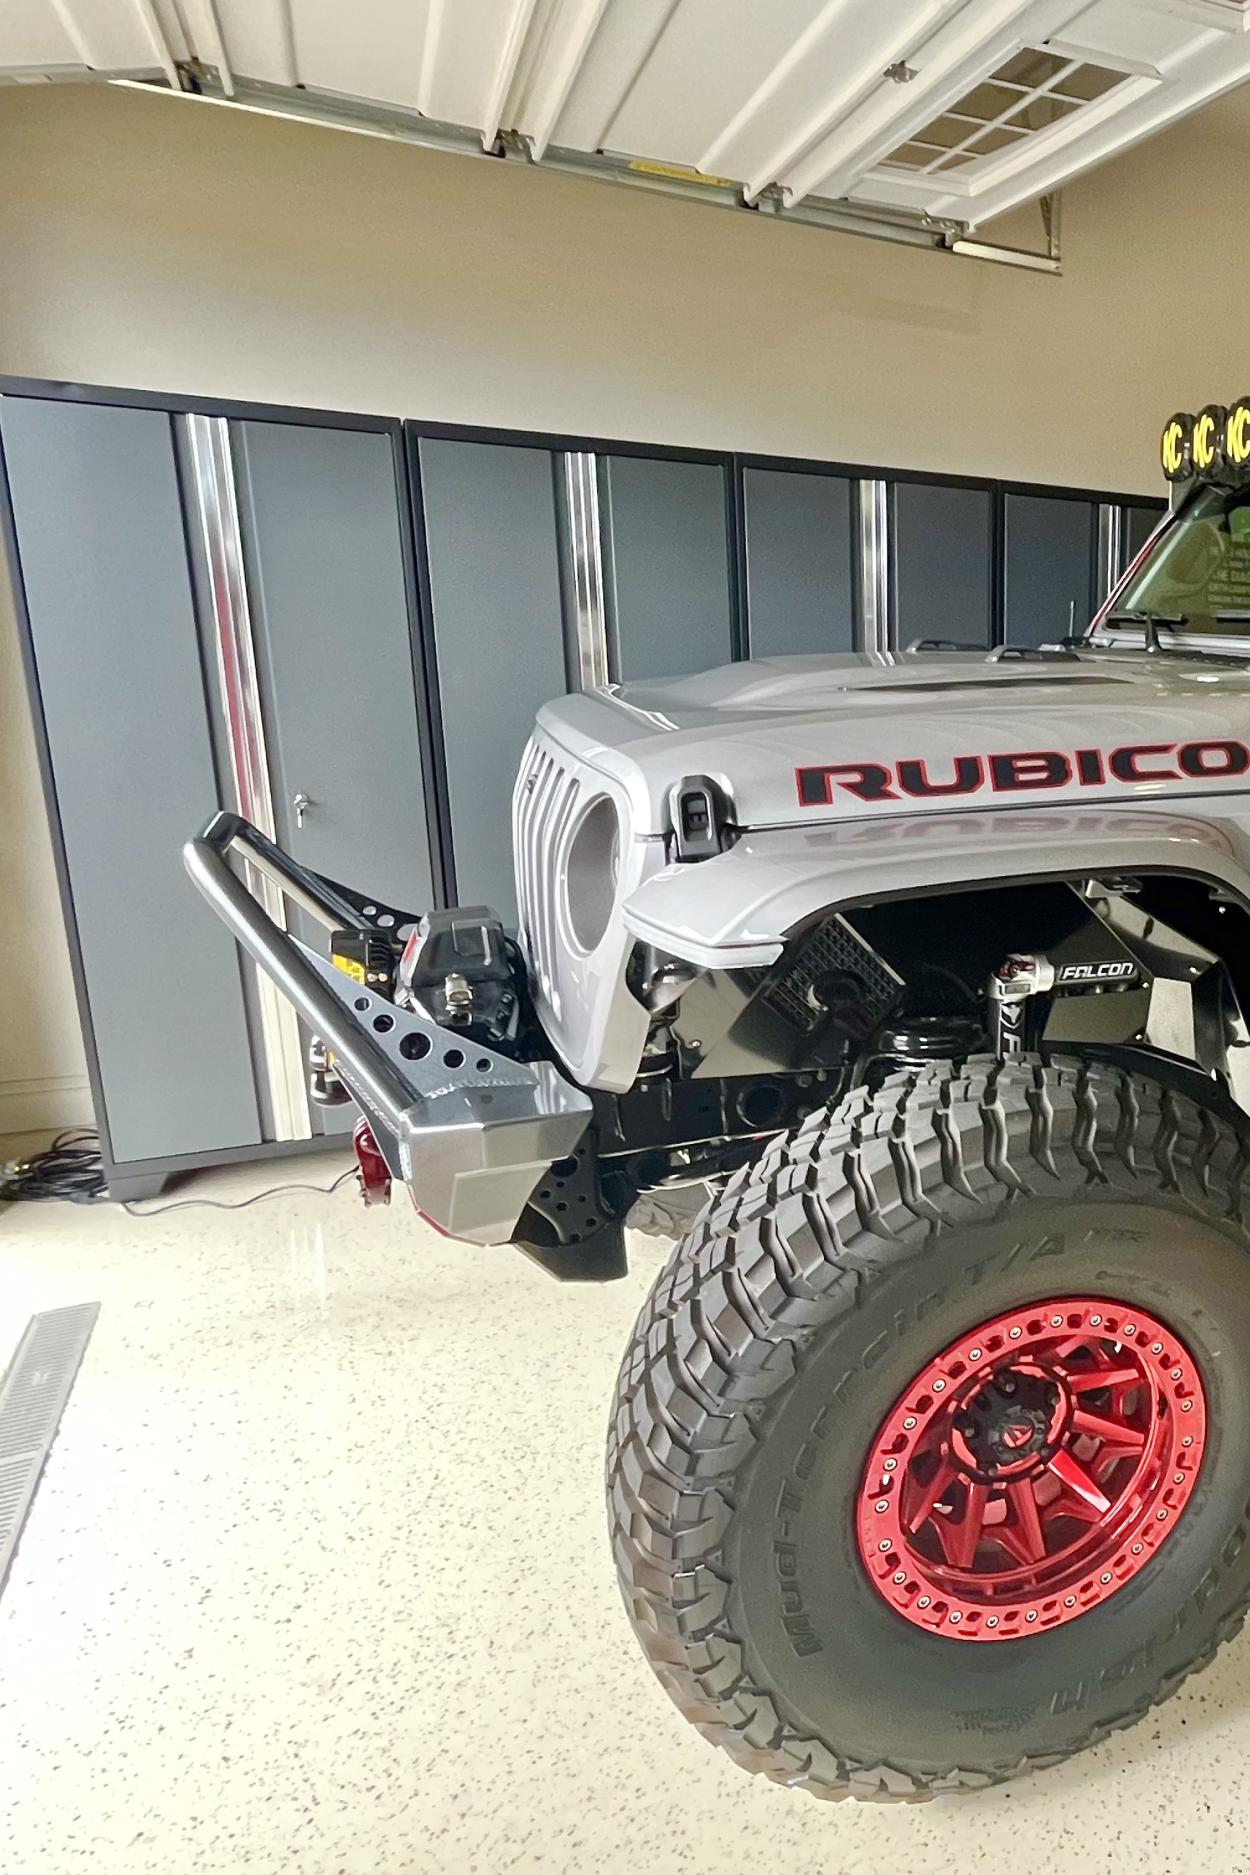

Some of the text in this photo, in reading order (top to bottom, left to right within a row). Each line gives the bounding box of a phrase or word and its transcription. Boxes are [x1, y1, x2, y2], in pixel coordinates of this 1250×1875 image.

[1162, 421, 1183, 473] KC
[1193, 414, 1215, 468] KC
[1062, 962, 1134, 981] FALCON
